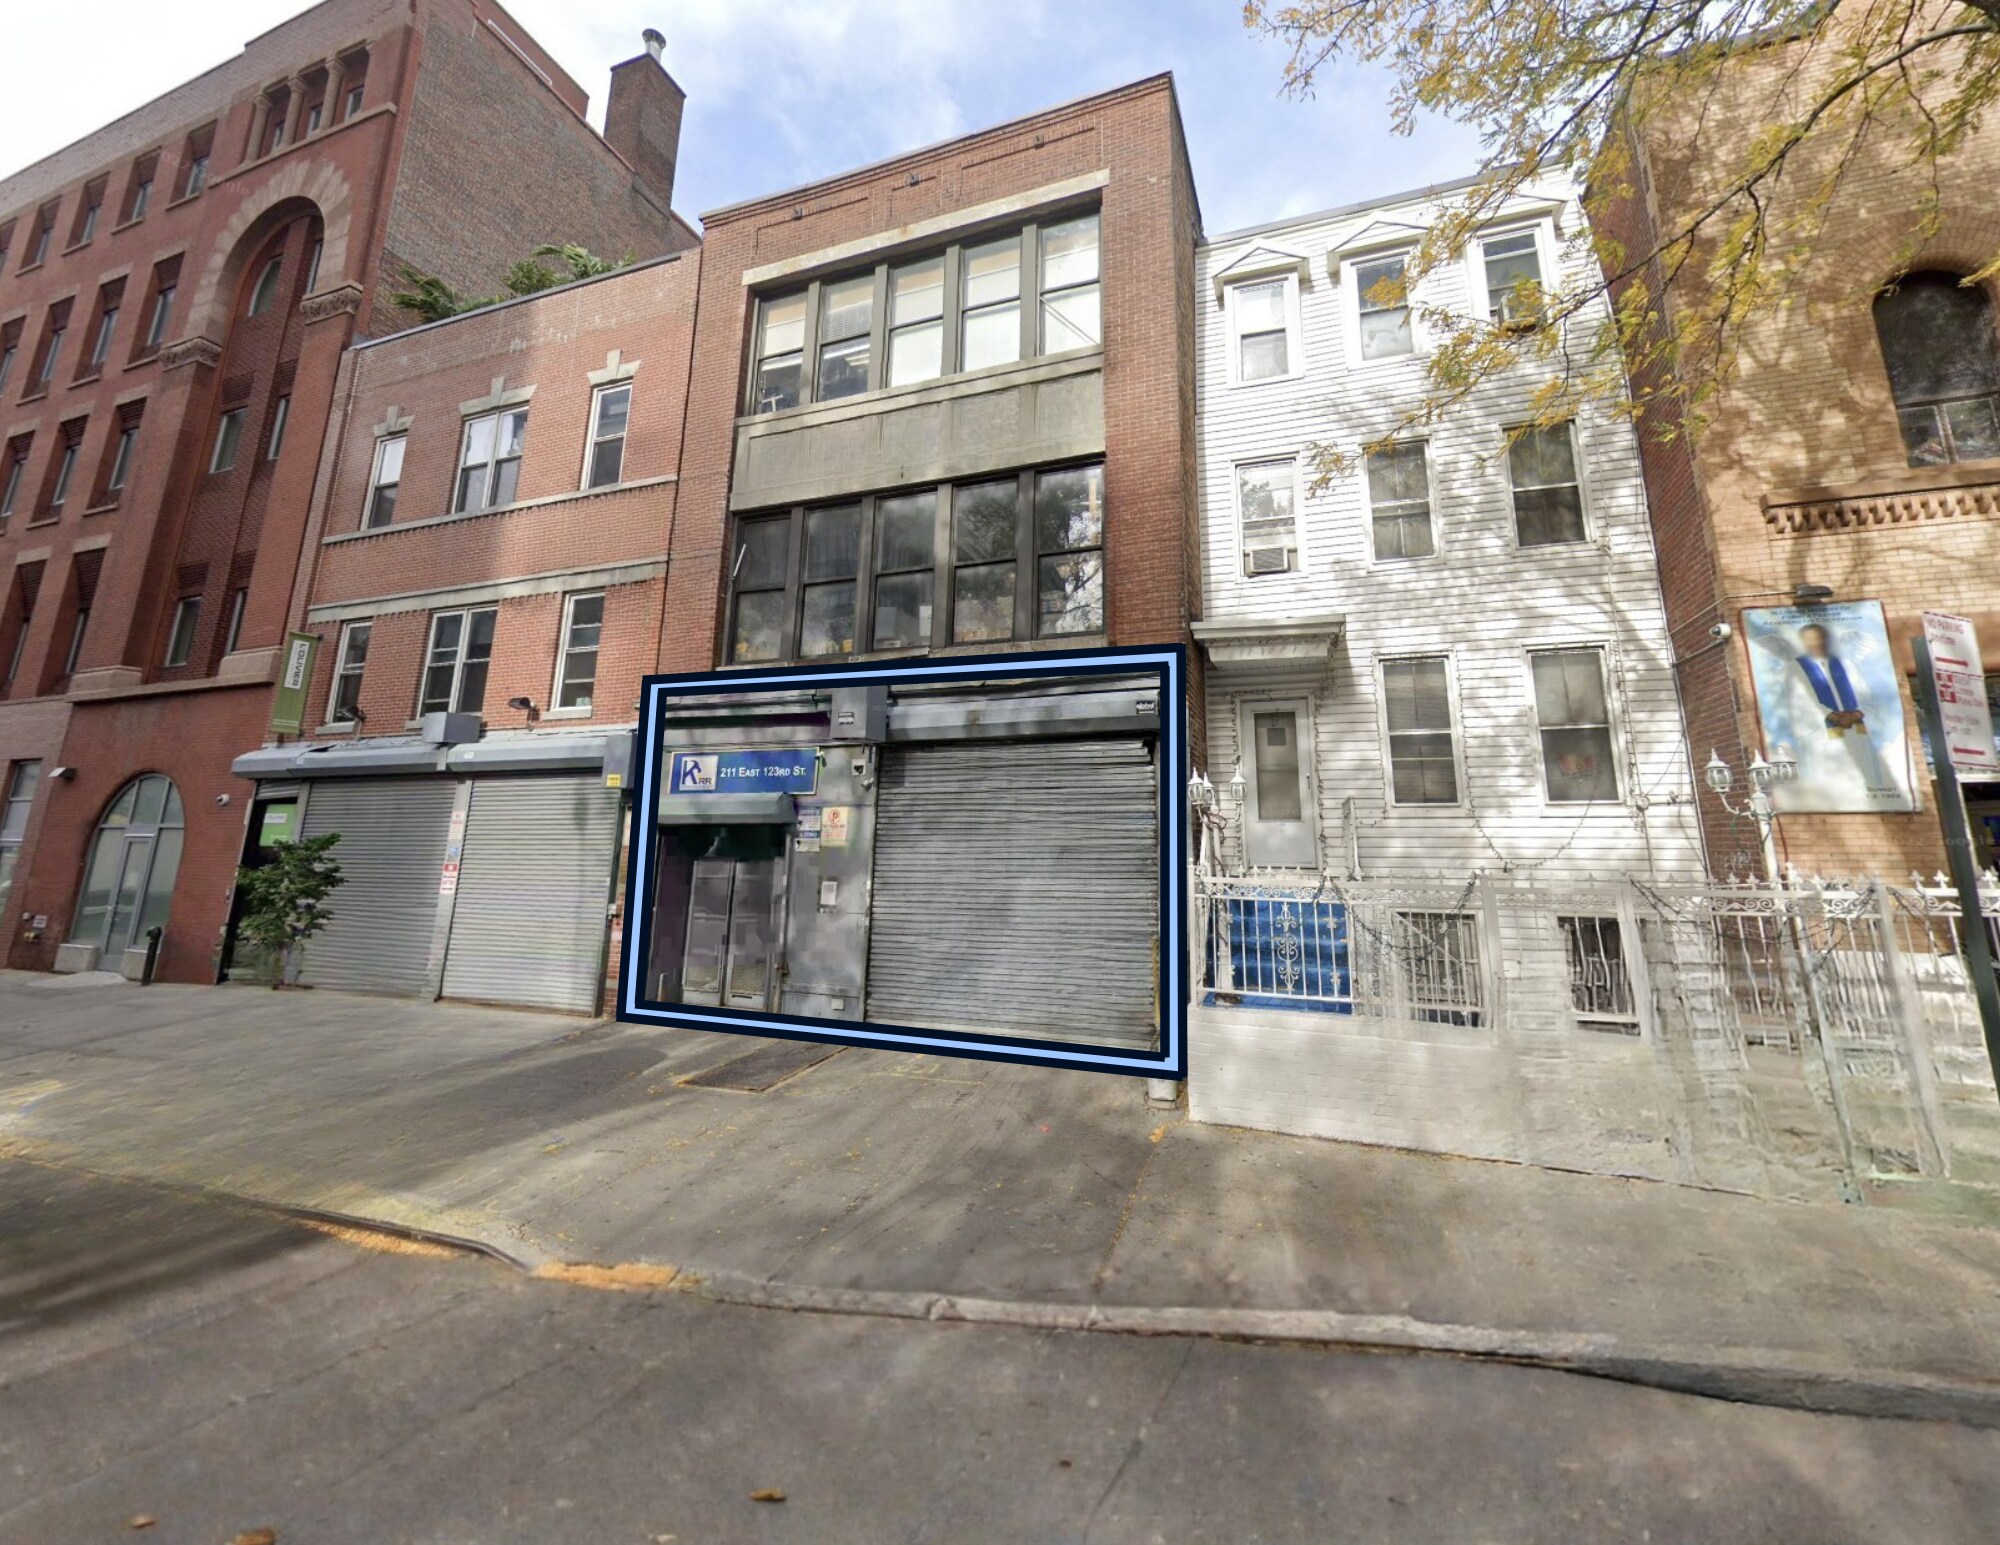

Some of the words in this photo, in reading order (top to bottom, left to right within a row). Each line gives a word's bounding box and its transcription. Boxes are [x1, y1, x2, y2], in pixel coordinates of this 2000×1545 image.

[720, 767, 737, 778] 211
[738, 767, 760, 778] EAST
[763, 765, 791, 777] 123RD
[792, 764, 807, 776] ST.
